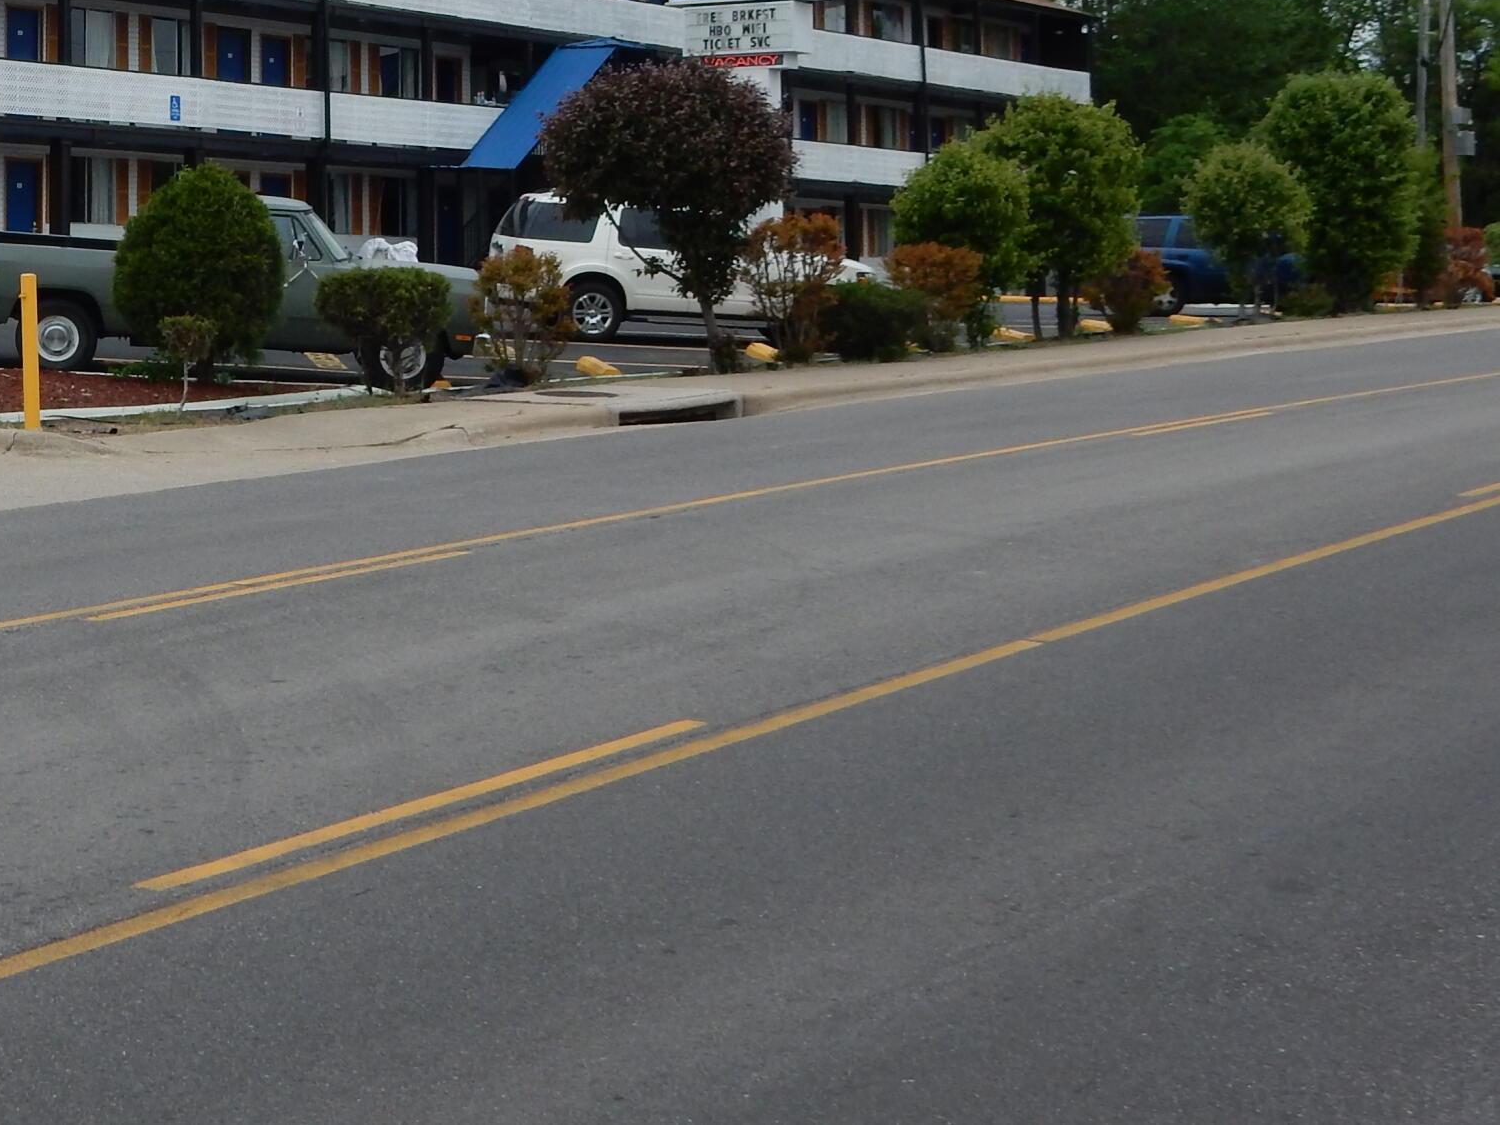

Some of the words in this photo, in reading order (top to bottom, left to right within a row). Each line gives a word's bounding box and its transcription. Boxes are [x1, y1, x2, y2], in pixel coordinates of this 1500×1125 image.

[732, 8, 776, 22] BRKFST
[709, 24, 732, 36] HBO
[742, 23, 767, 35] WIFI
[702, 37, 741, 50] TICET
[750, 35, 771, 48] SVC
[703, 55, 779, 68] VACANCY
